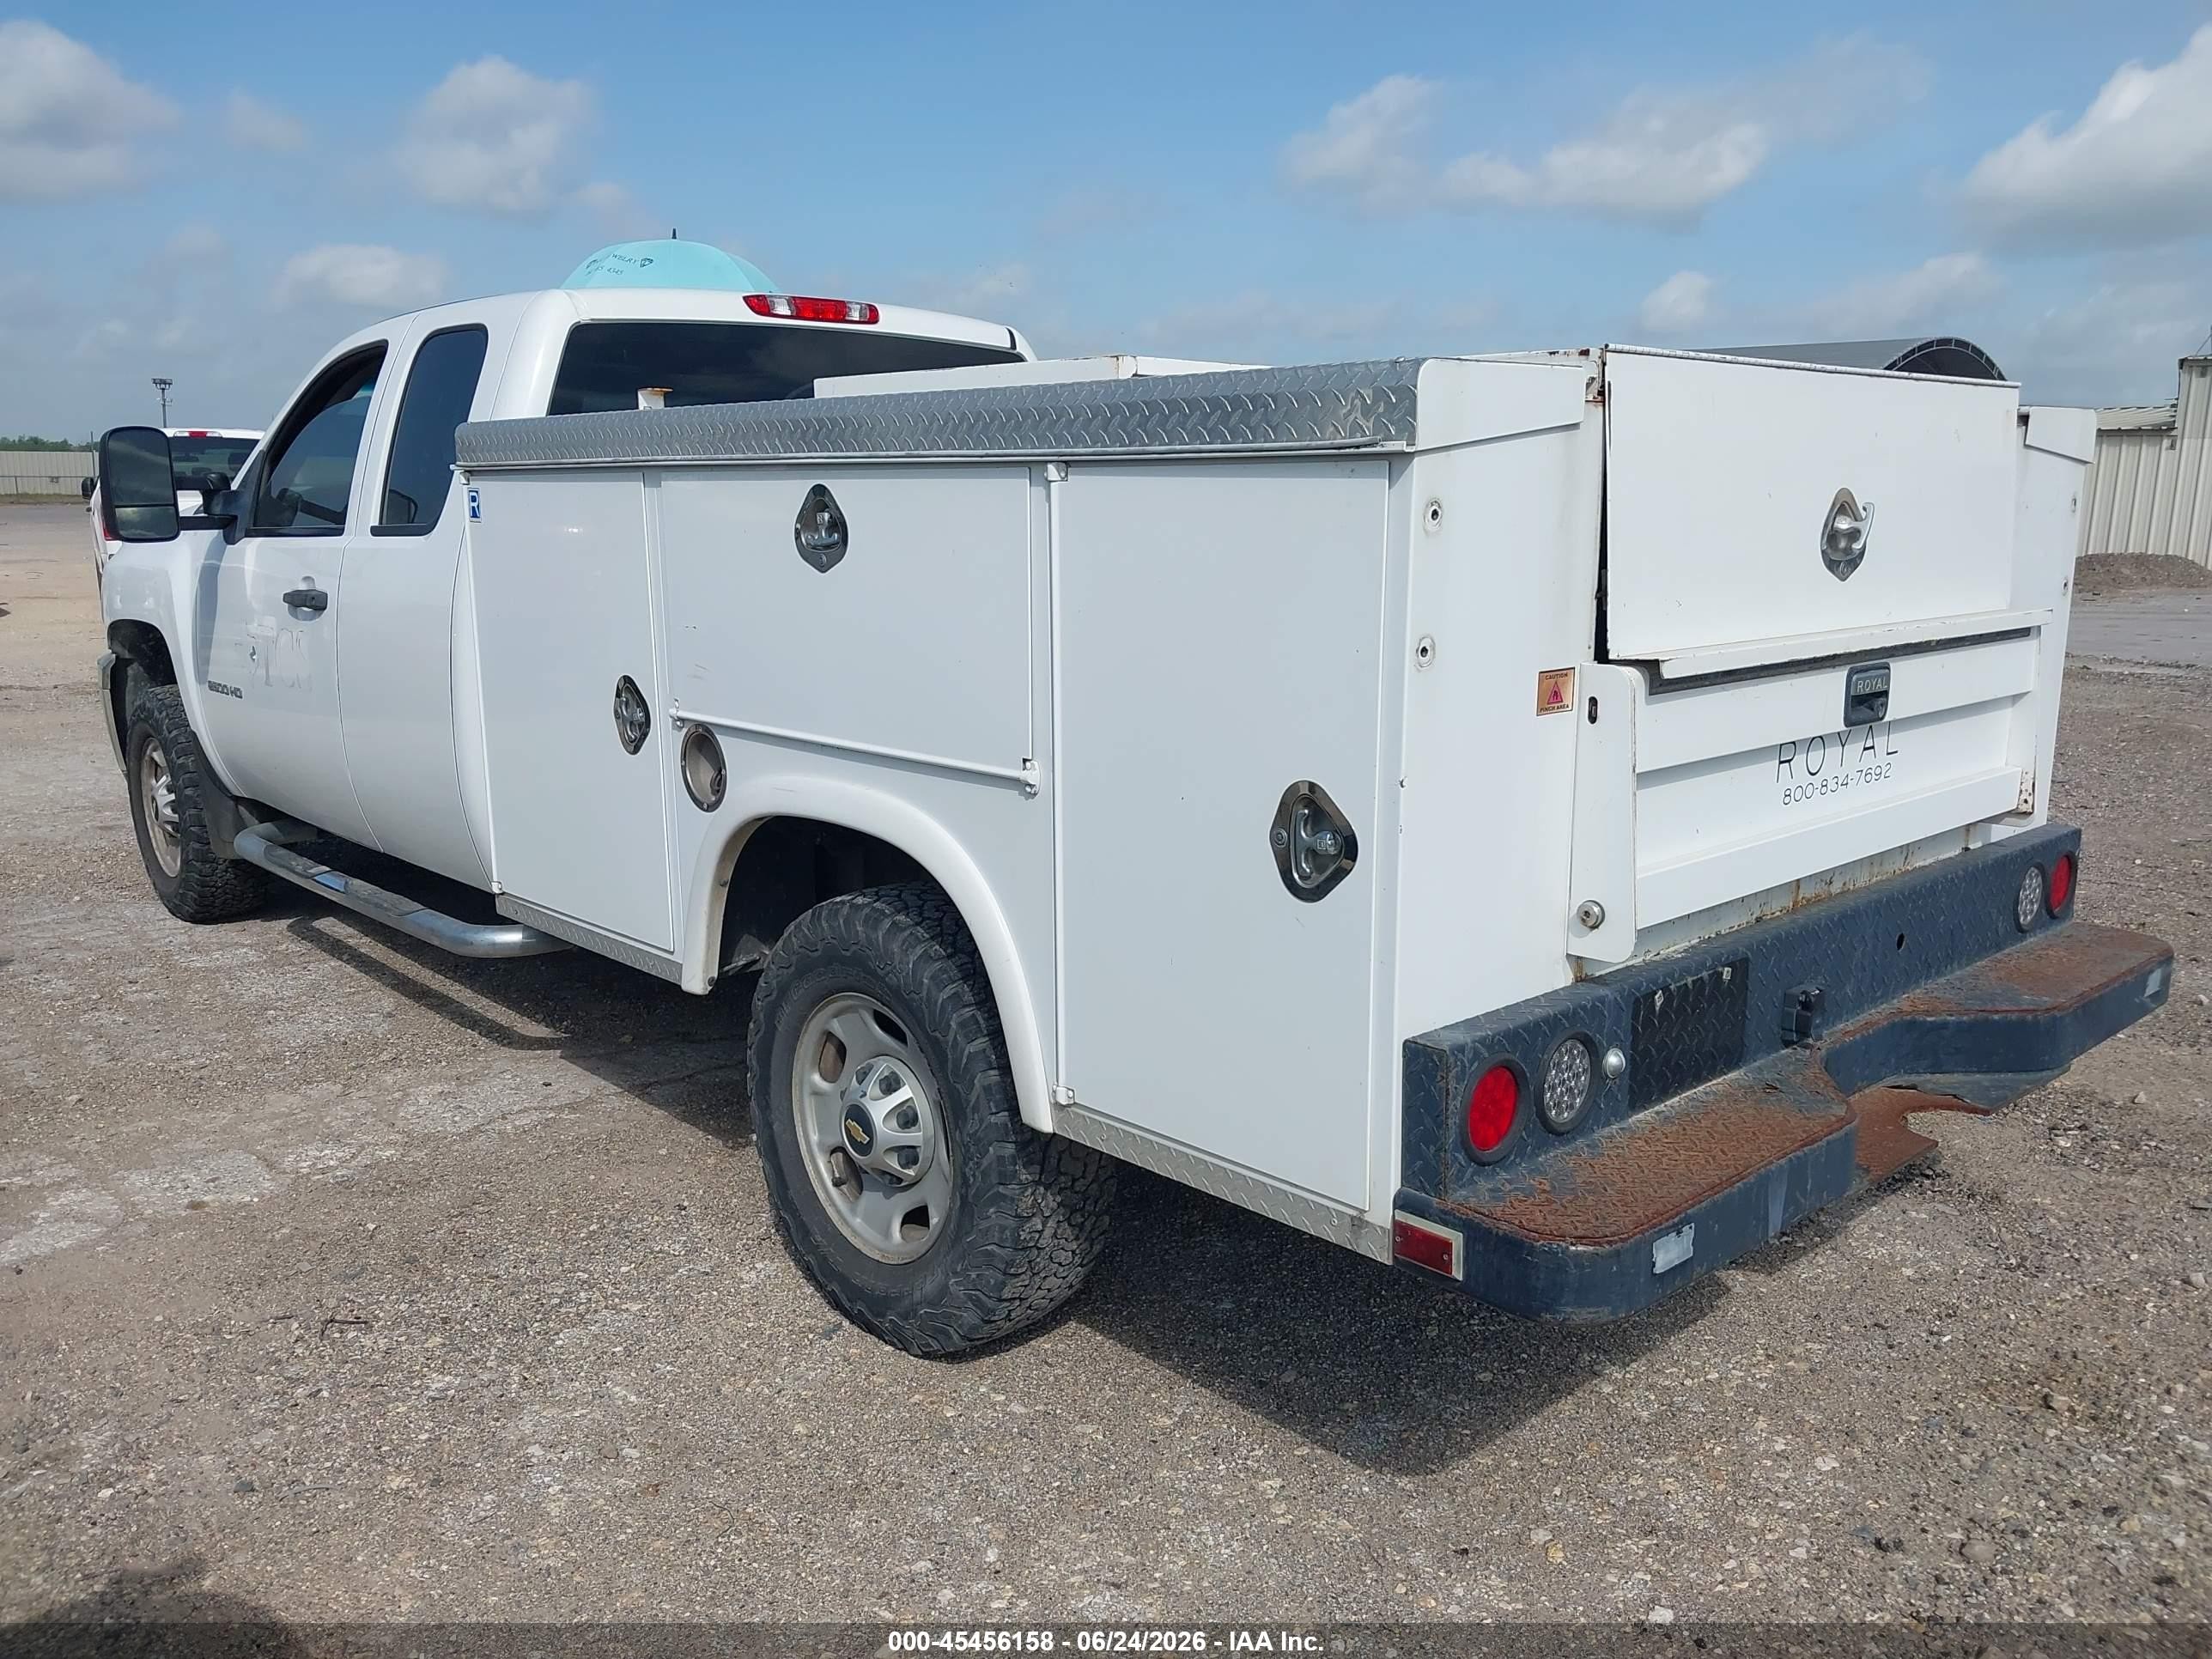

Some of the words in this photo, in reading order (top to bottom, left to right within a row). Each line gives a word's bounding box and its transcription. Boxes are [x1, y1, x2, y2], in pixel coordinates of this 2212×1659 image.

[469, 490, 480, 517] R
[1856, 676, 1889, 693] ROYAL
[1776, 720, 1899, 783] ROYAL
[1782, 762, 1893, 806] 800-834-7692
